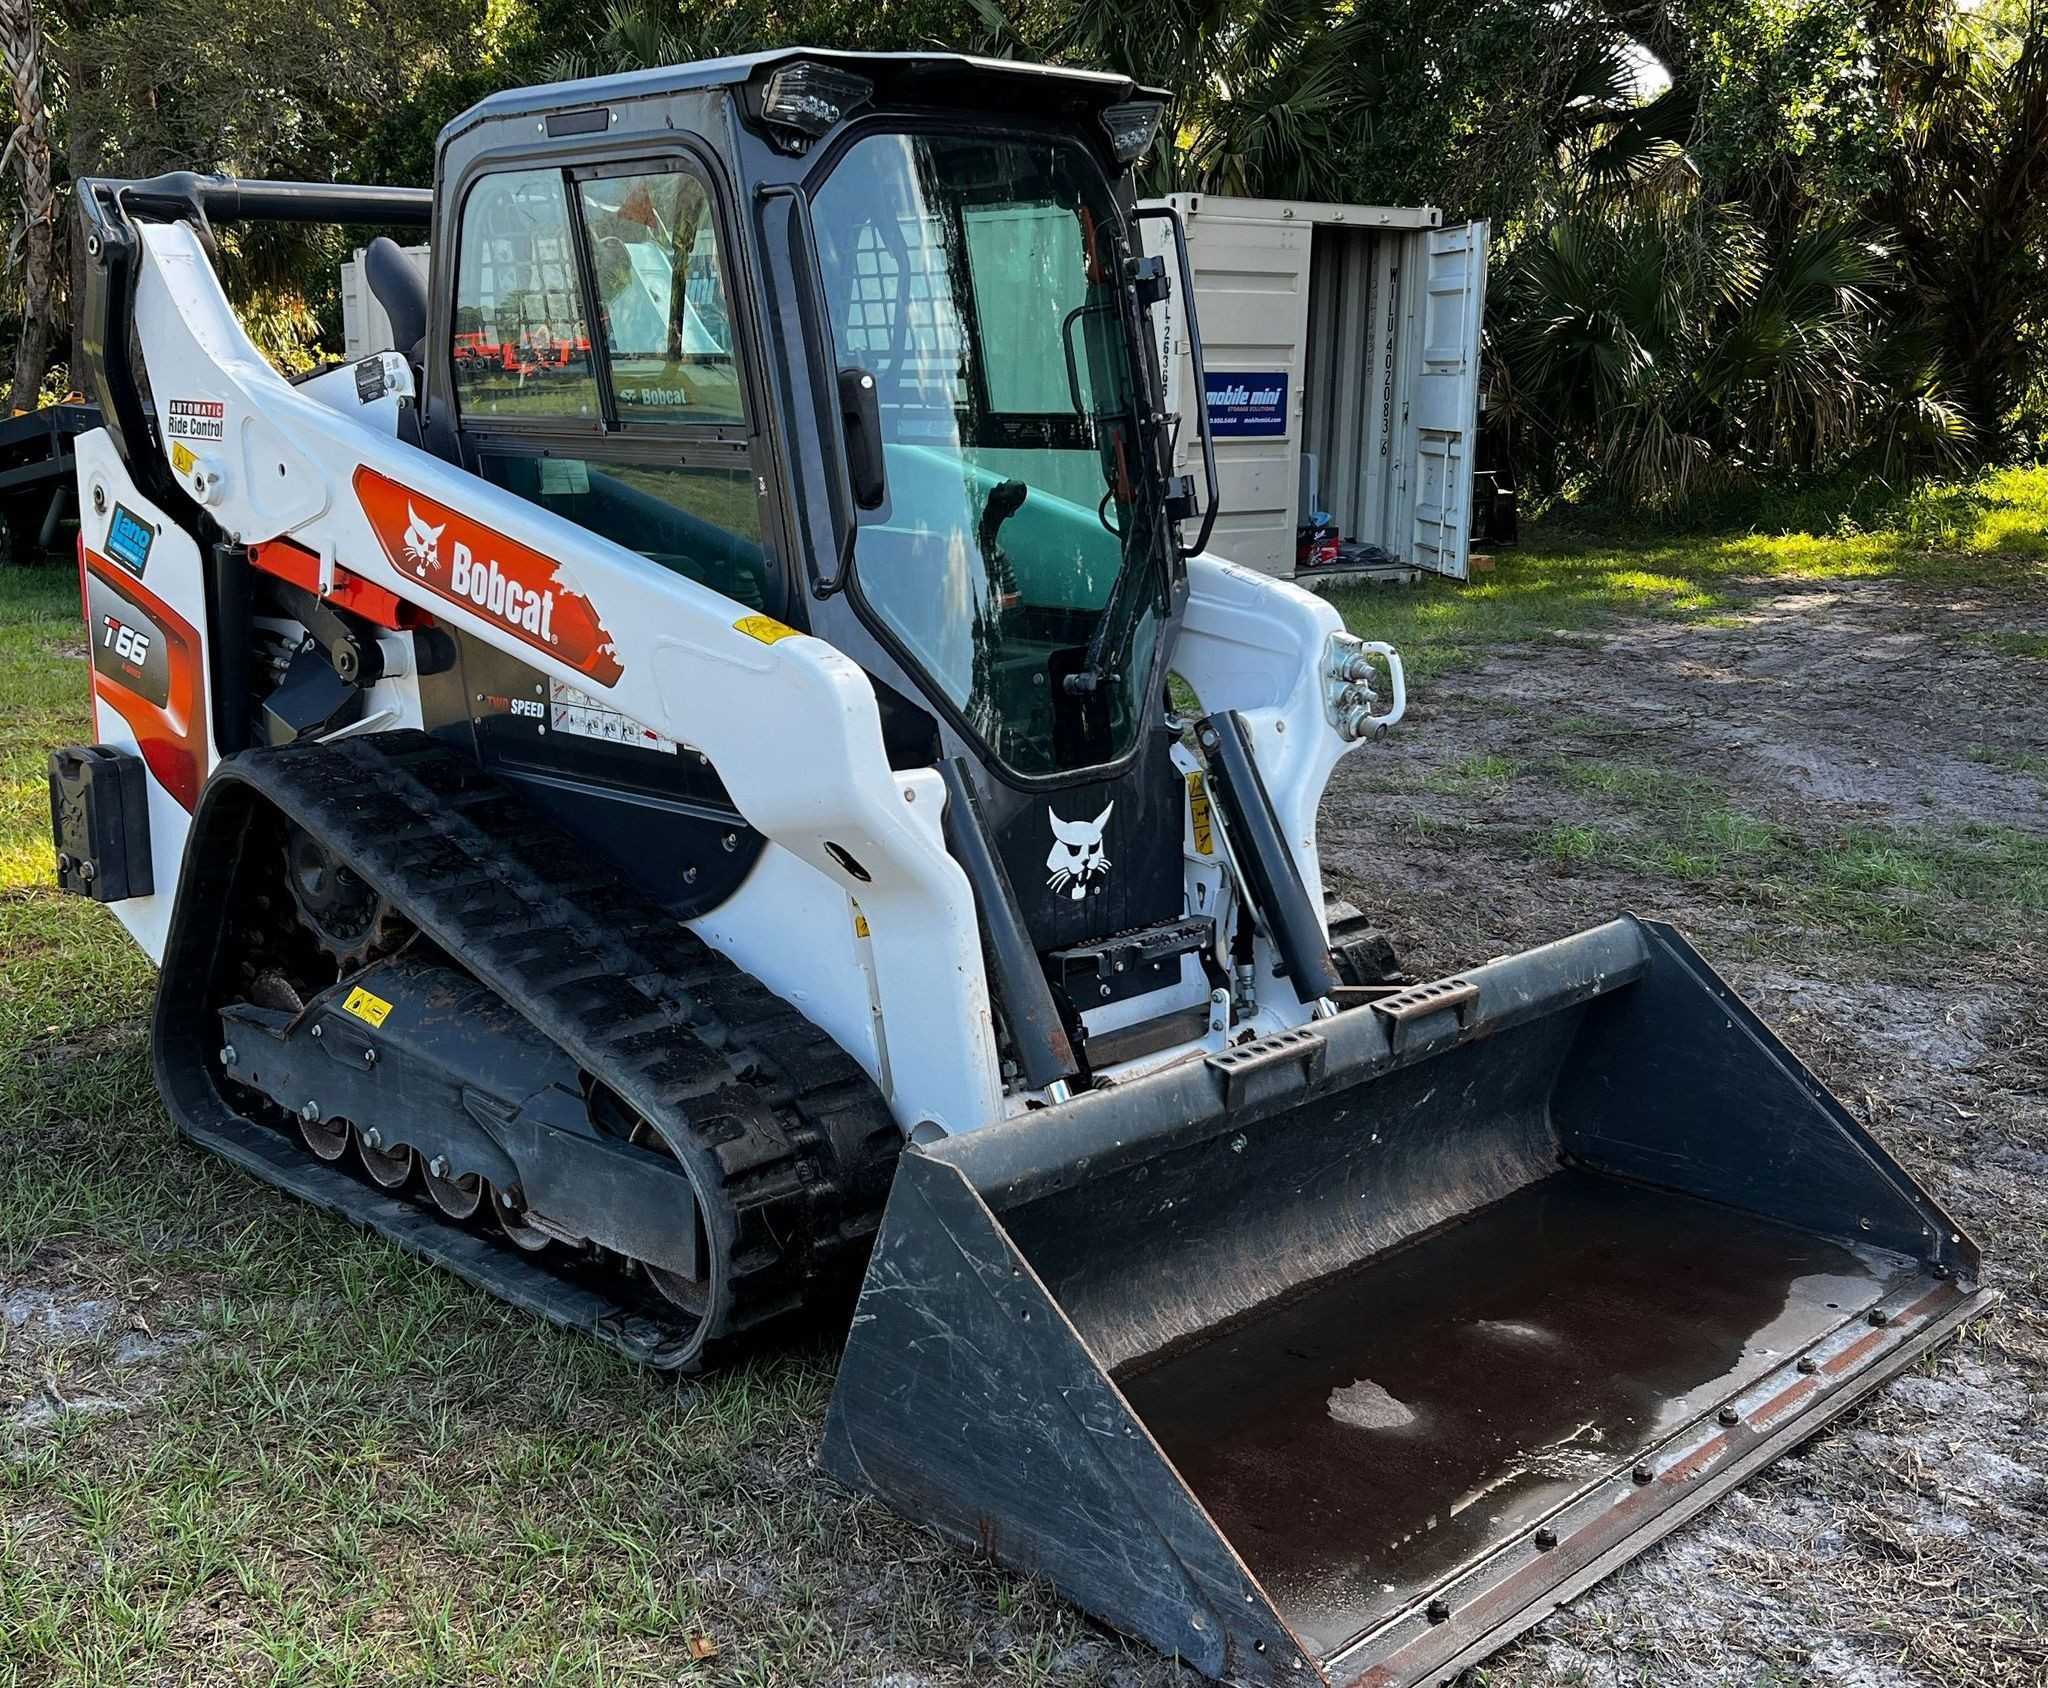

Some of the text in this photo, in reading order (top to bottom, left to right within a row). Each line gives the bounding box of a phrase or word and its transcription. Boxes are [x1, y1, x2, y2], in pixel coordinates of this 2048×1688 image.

[641, 387, 687, 405] Bobcat
[1206, 385, 1282, 405] mobile mini
[170, 401, 223, 418] AUTOMATIC
[168, 416, 223, 438] Ride Control
[451, 541, 554, 642] Bobcat
[103, 614, 150, 667] T66
[510, 698, 545, 718] SPEED
